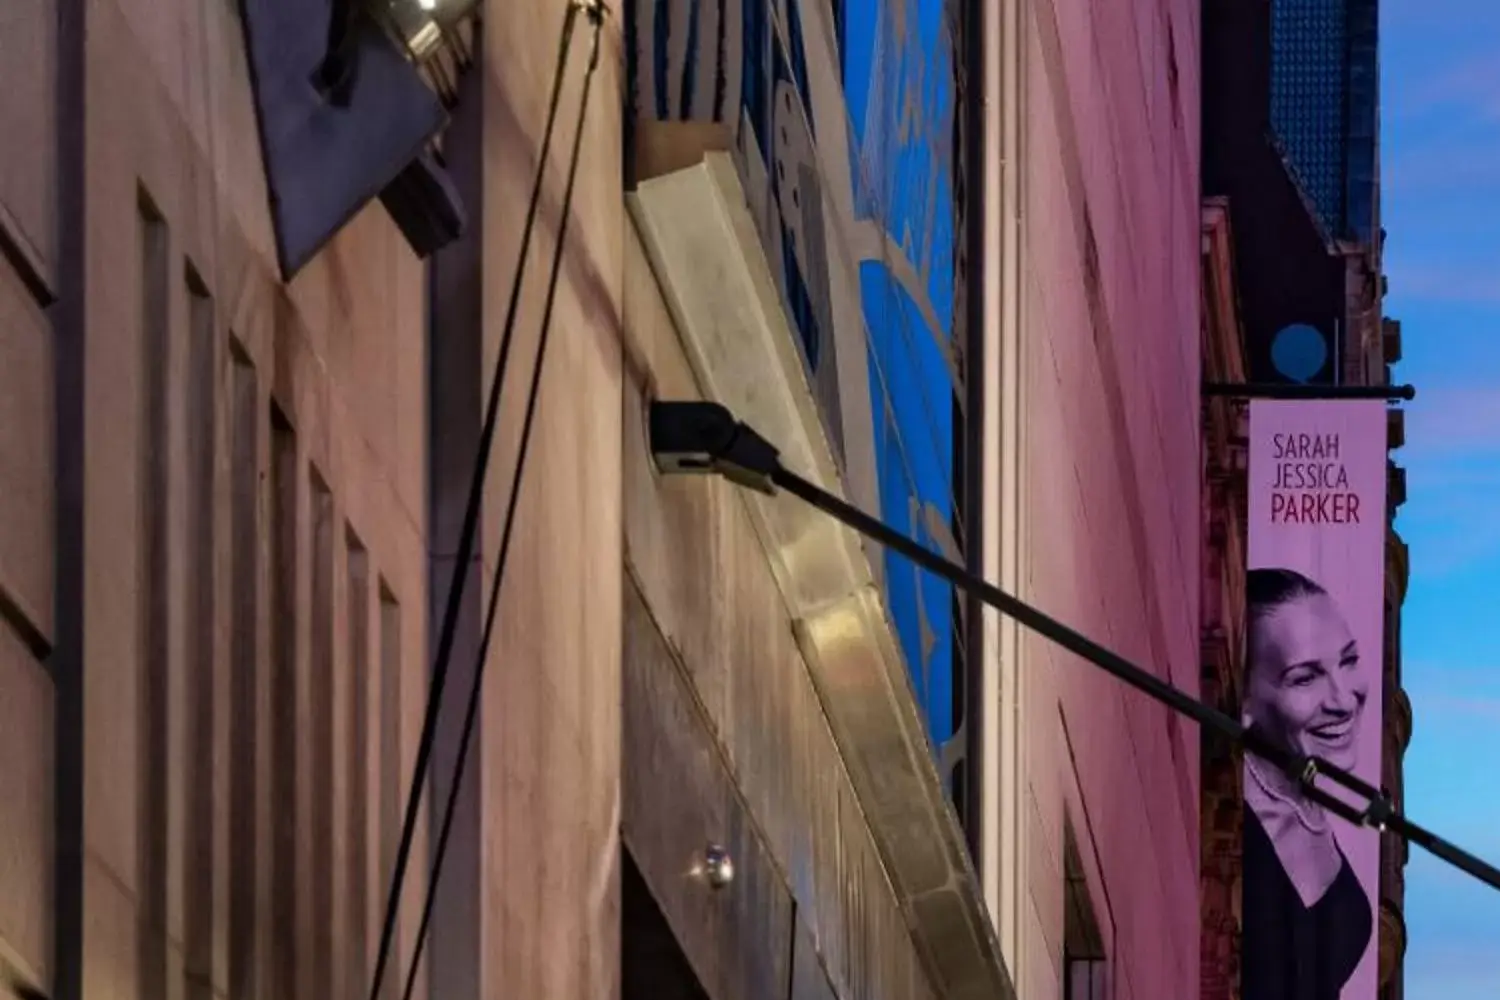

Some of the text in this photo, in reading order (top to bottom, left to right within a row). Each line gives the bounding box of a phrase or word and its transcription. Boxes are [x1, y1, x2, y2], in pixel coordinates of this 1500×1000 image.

[1272, 432, 1340, 460] SARAH
[1272, 462, 1349, 489] JESSICA
[1270, 493, 1361, 524] PARKER
